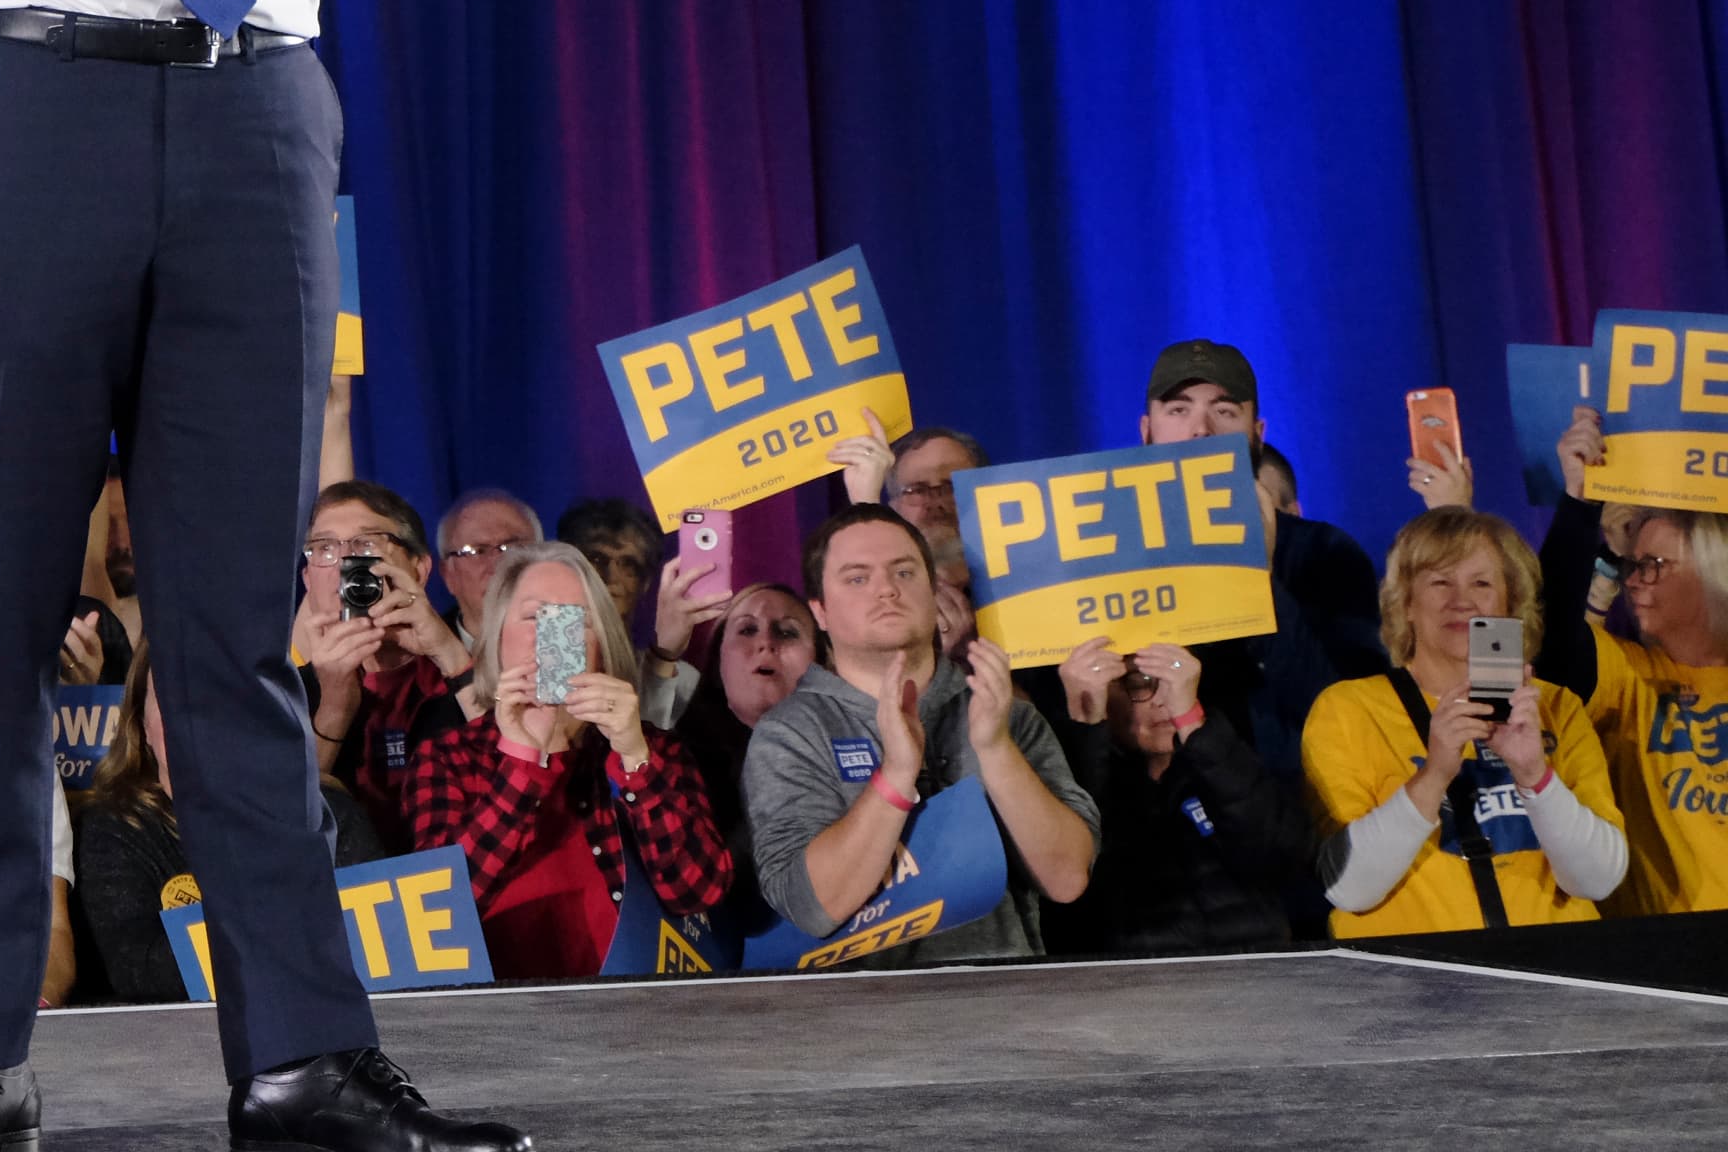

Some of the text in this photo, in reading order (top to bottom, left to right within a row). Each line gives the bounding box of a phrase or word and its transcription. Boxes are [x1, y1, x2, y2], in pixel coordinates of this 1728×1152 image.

[620, 267, 879, 444] PETE
[1606, 324, 1728, 414] PE
[737, 409, 839, 468] 2020
[1684, 449, 1728, 478] 20
[975, 452, 1246, 580] PETE
[1077, 584, 1177, 625] 2020
[1477, 789, 1525, 815] ETE
[849, 899, 891, 932] for
